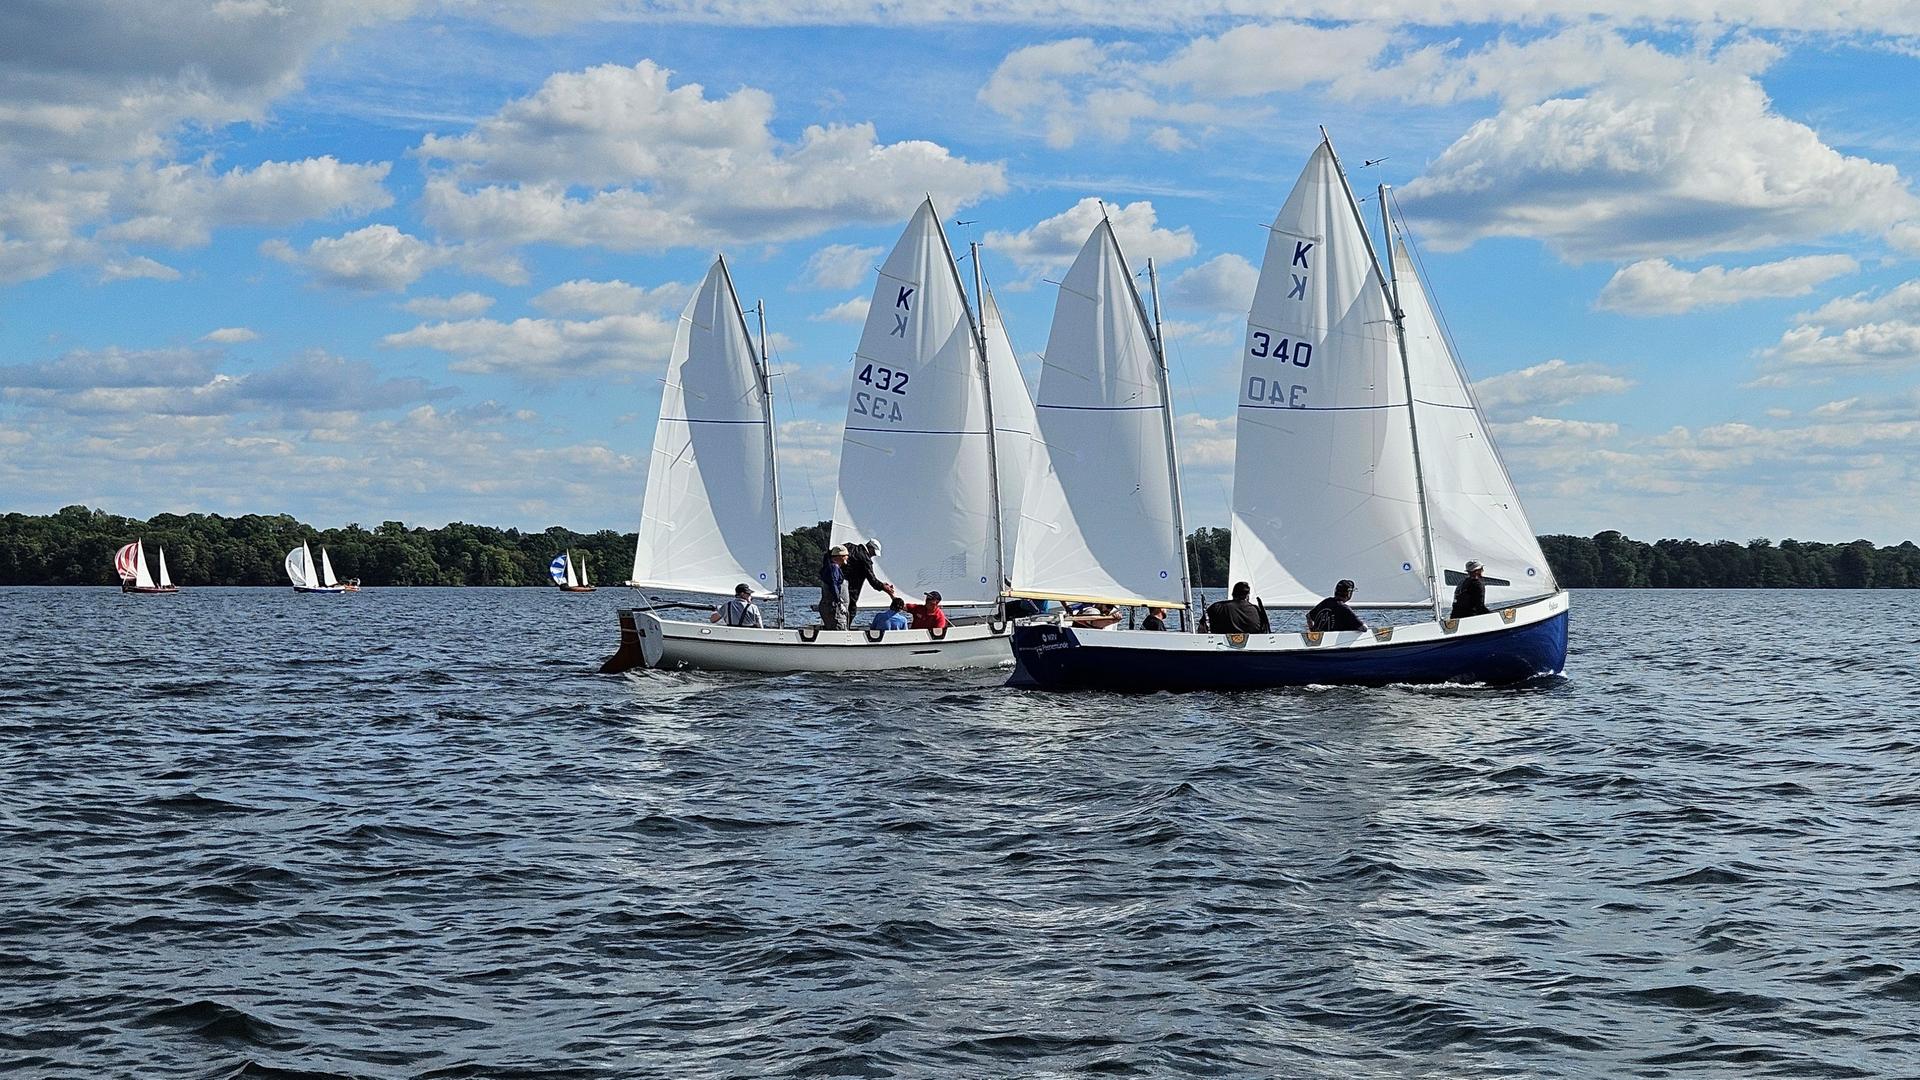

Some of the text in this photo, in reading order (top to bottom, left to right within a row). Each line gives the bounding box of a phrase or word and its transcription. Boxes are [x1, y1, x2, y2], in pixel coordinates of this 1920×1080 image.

[1292, 241, 1313, 269] K
[896, 286, 914, 311] K
[1251, 331, 1313, 368] 340
[858, 364, 909, 395] 432
